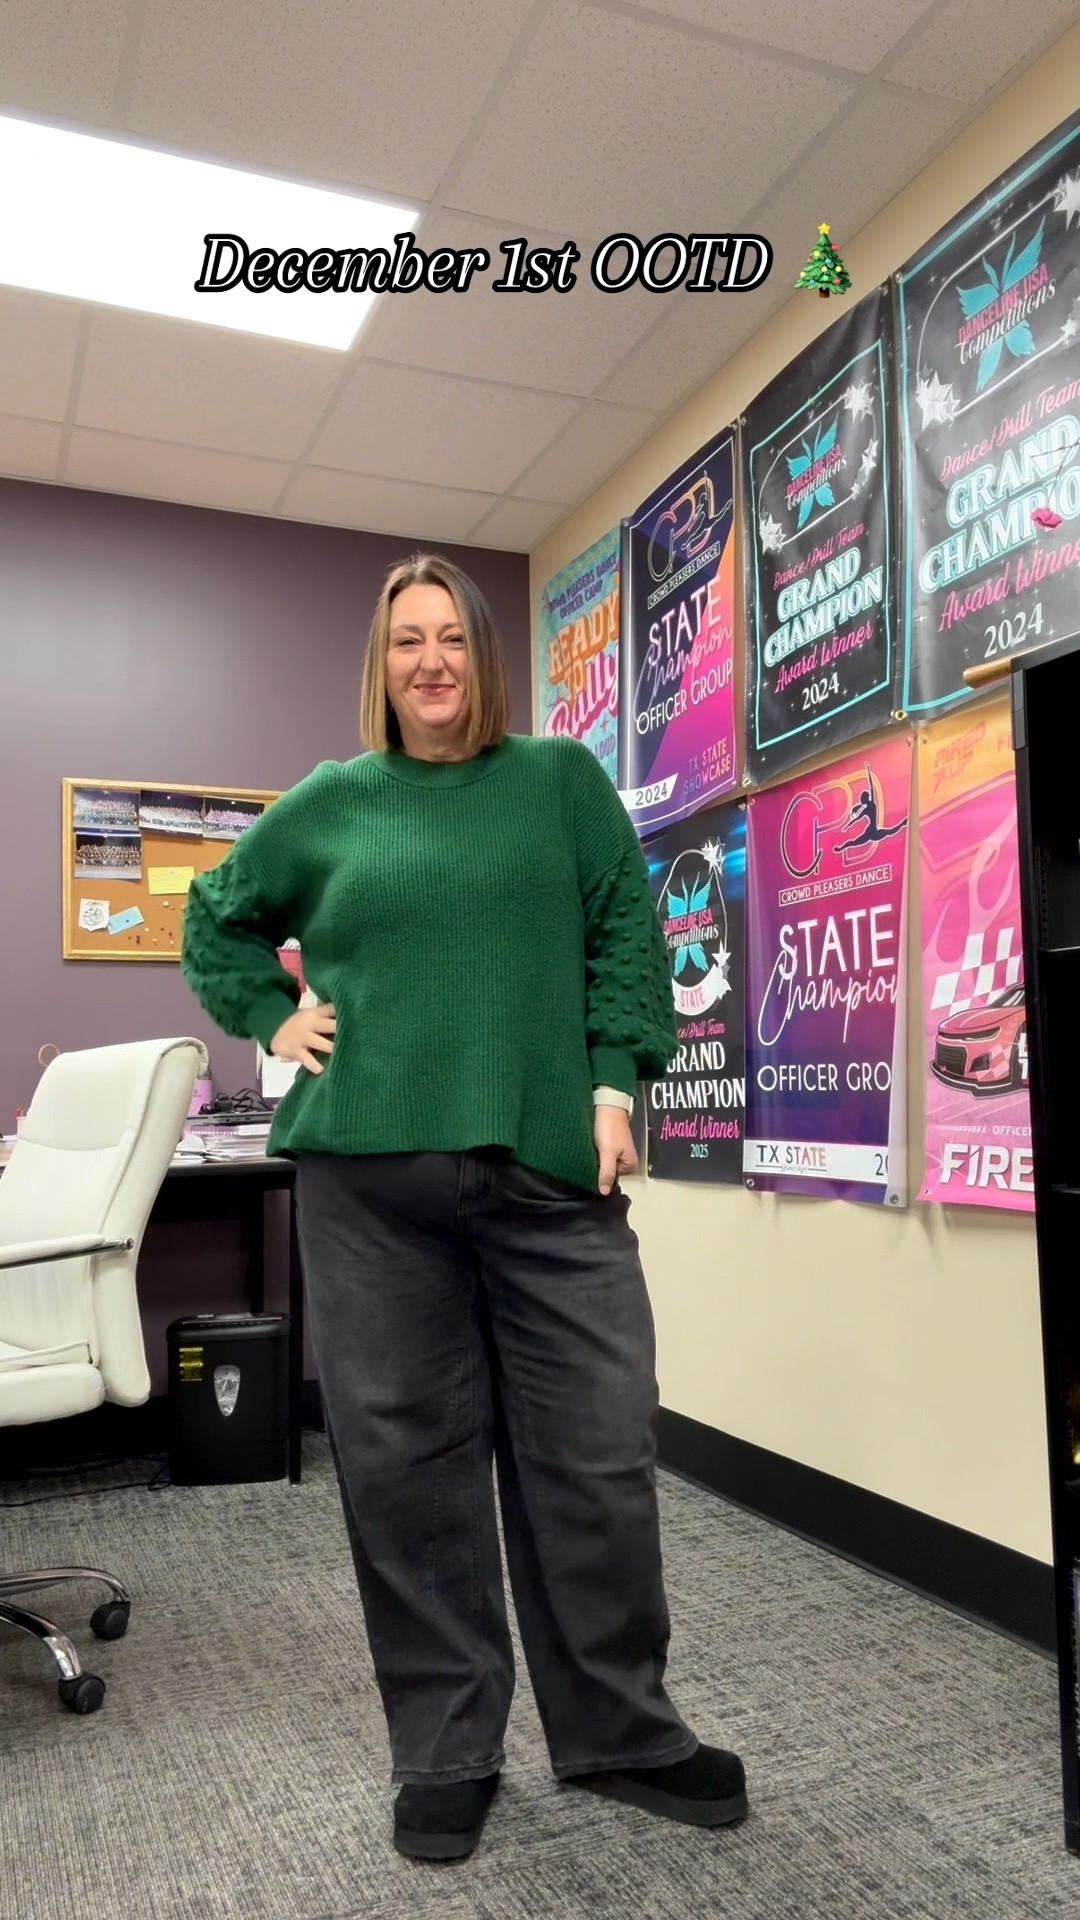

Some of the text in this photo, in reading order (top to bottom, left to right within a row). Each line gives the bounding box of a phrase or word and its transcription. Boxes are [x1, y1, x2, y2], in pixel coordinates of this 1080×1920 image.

[954, 279, 1056, 364] Competitions
[958, 263, 1049, 342] DANCELINE USA
[825, 444, 843, 470] USA
[946, 414, 1080, 528] GRAND
[836, 521, 865, 550] Team
[696, 546, 719, 569] DANCE
[777, 546, 860, 623] GRAND
[938, 561, 1010, 632] Award
[649, 575, 722, 665] STATE
[764, 565, 883, 667] CHAMPION
[984, 602, 1044, 659] 2024
[549, 592, 618, 682] READY
[774, 620, 873, 693] Award Winner
[636, 658, 732, 734] OFFICER GROUP
[802, 671, 839, 710] 2024
[689, 737, 728, 774] TX STATE
[635, 783, 667, 807] 2024
[684, 758, 731, 795] SHOWCASE
[781, 866, 889, 904] CROWD PLEASERS DANCE
[779, 903, 895, 980] STATE
[680, 986, 705, 1008] STATE
[651, 1078, 745, 1110] CHAMPION
[757, 1062, 892, 1092] OFFICER GRO
[660, 1114, 741, 1140] Award Winner
[690, 1144, 709, 1158] 2025
[757, 1144, 779, 1163] TX
[785, 1145, 827, 1168] STATE
